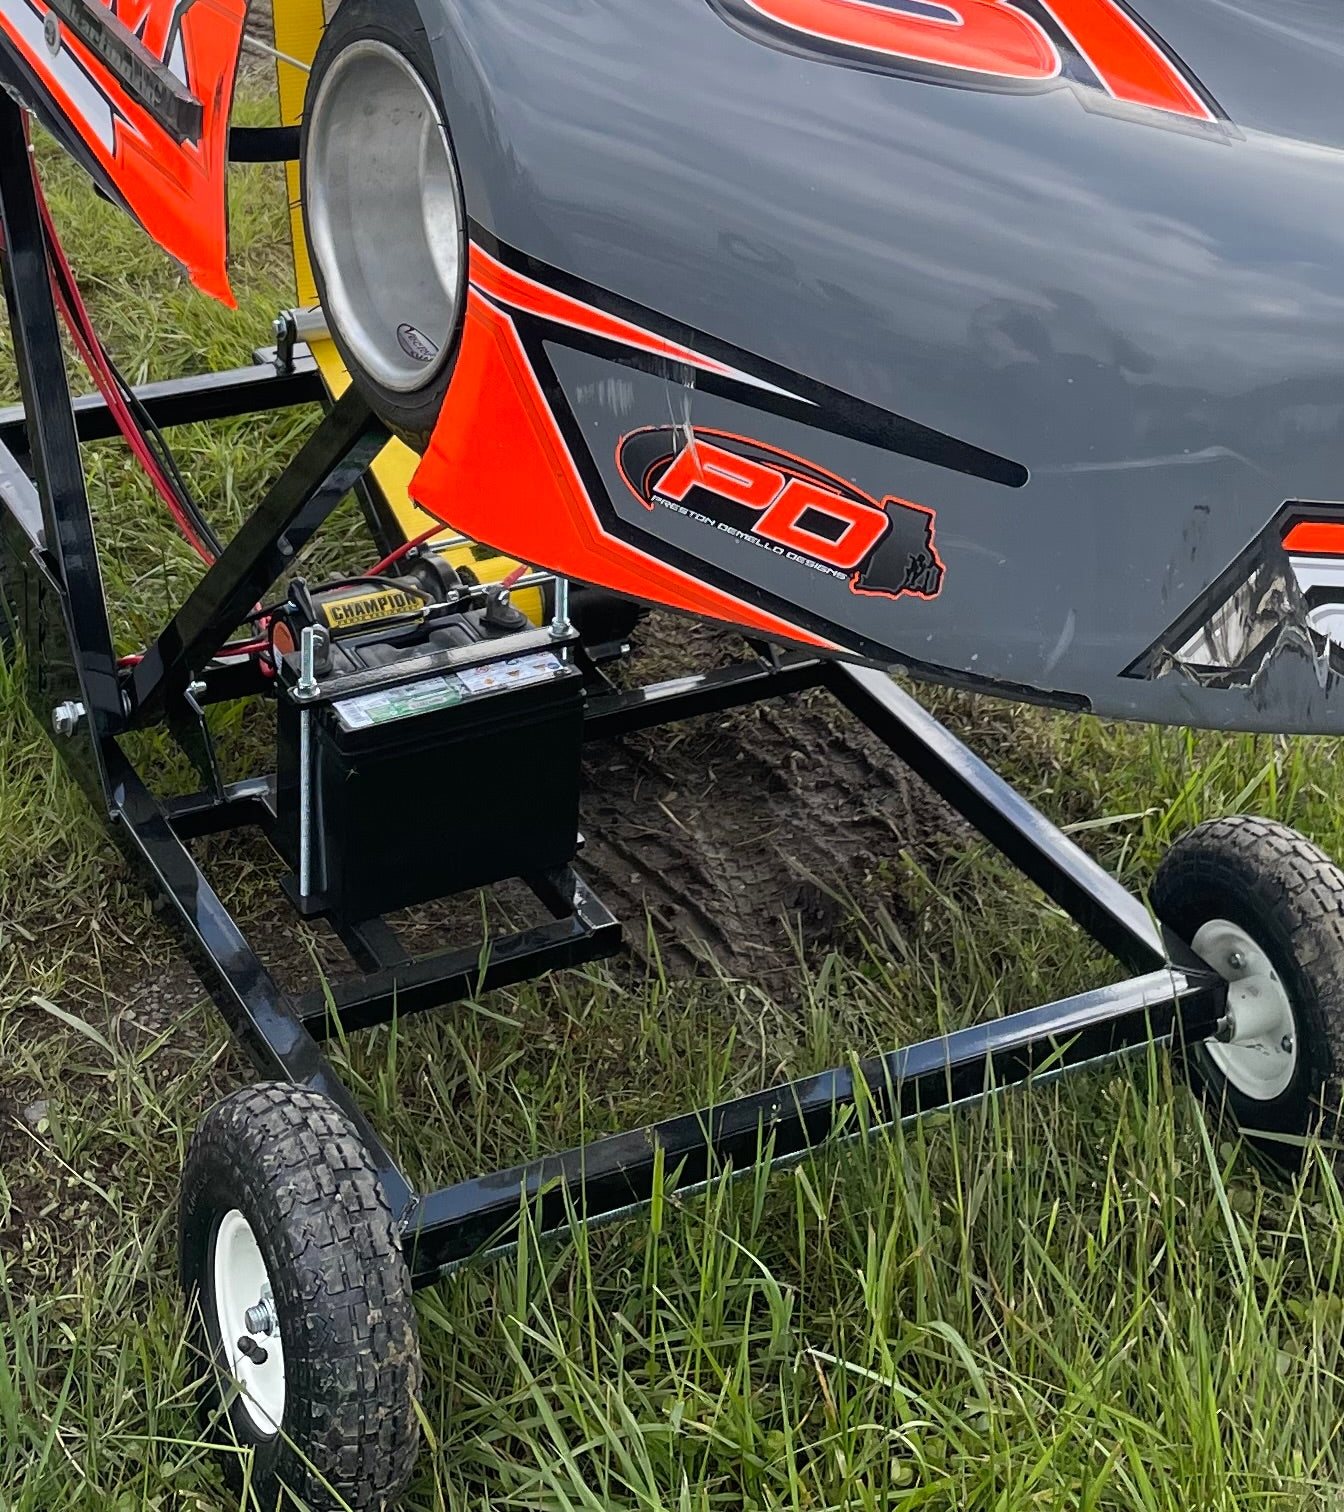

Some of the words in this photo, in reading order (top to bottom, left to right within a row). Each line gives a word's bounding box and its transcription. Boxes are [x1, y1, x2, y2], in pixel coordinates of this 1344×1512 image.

[651, 494, 716, 526] PRESTON
[717, 519, 784, 556] DEMELLO
[785, 549, 849, 581] DESIGNS
[331, 591, 417, 620] CHAMPION
